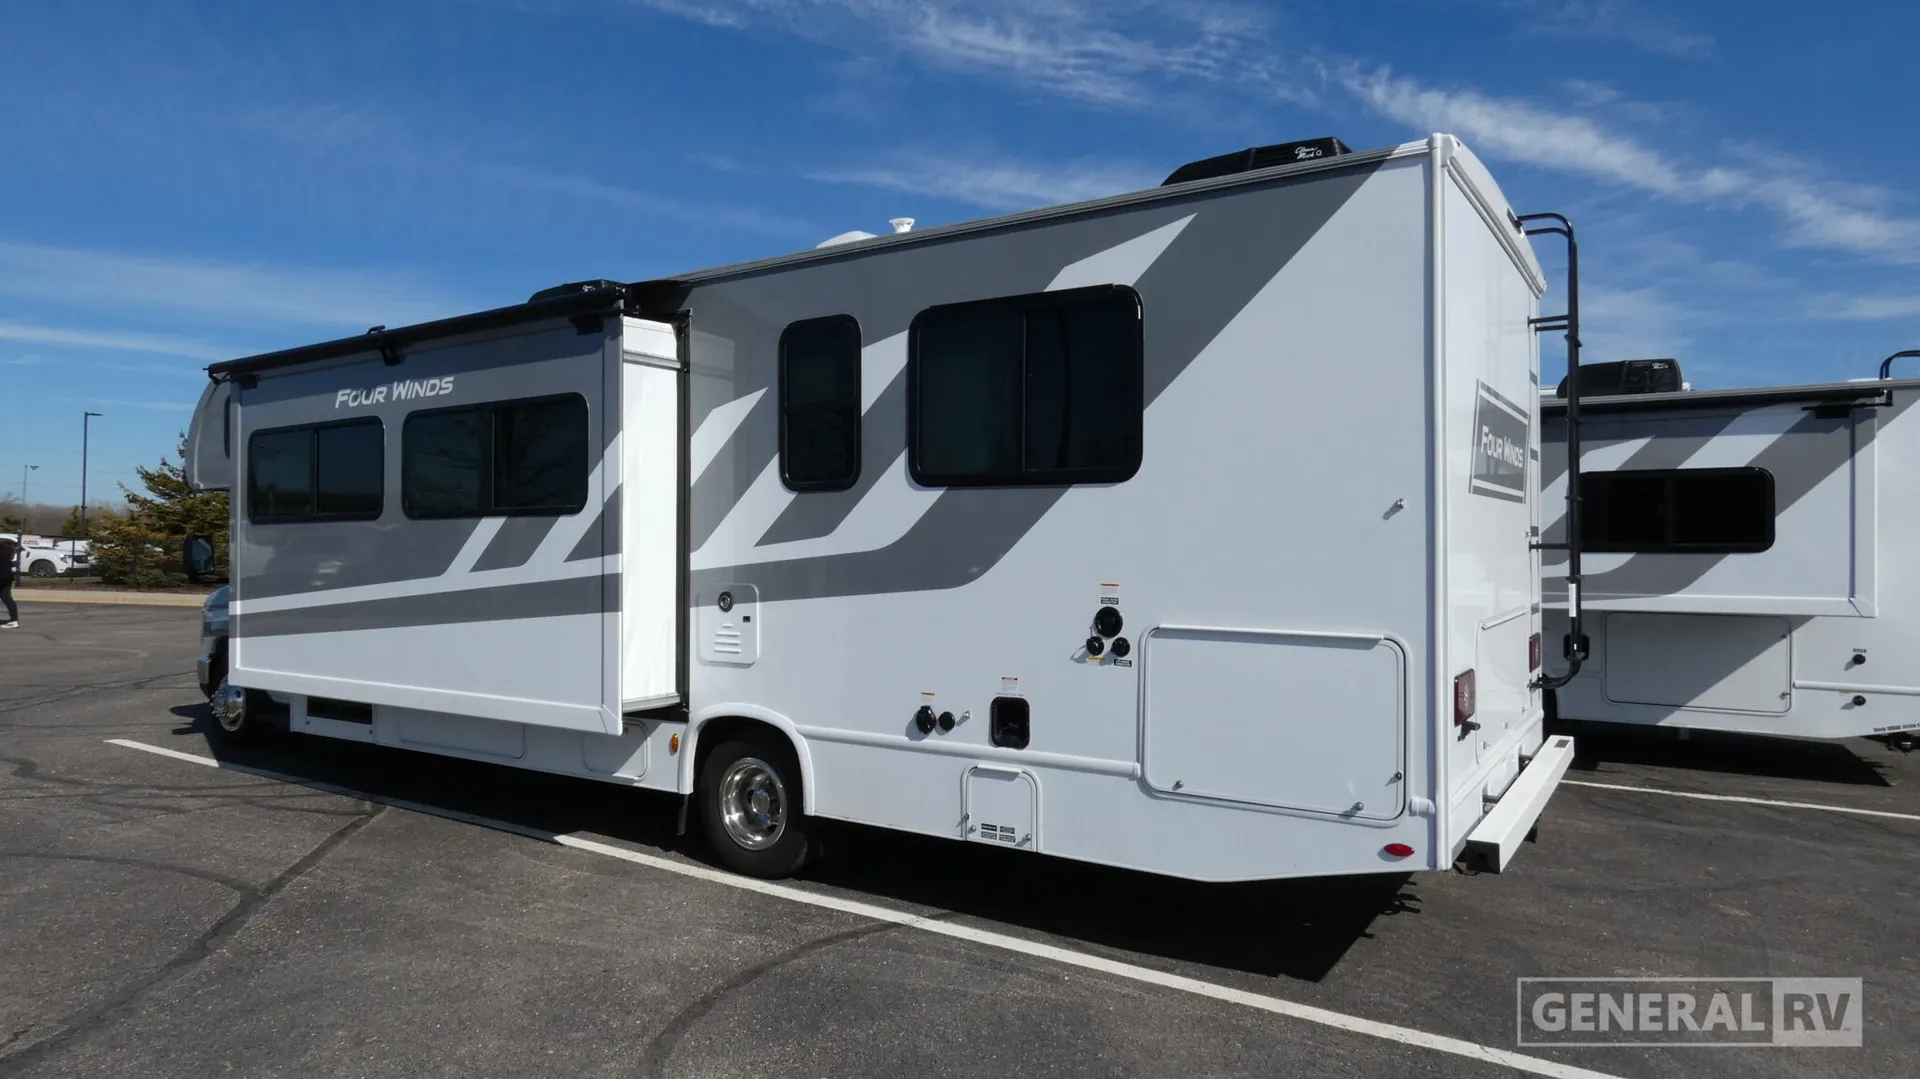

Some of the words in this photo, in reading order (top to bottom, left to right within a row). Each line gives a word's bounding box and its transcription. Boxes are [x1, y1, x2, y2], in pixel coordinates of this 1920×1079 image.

[335, 387, 388, 408] FOUR
[392, 376, 455, 401] WINDS
[1481, 425, 1503, 461] FOUR
